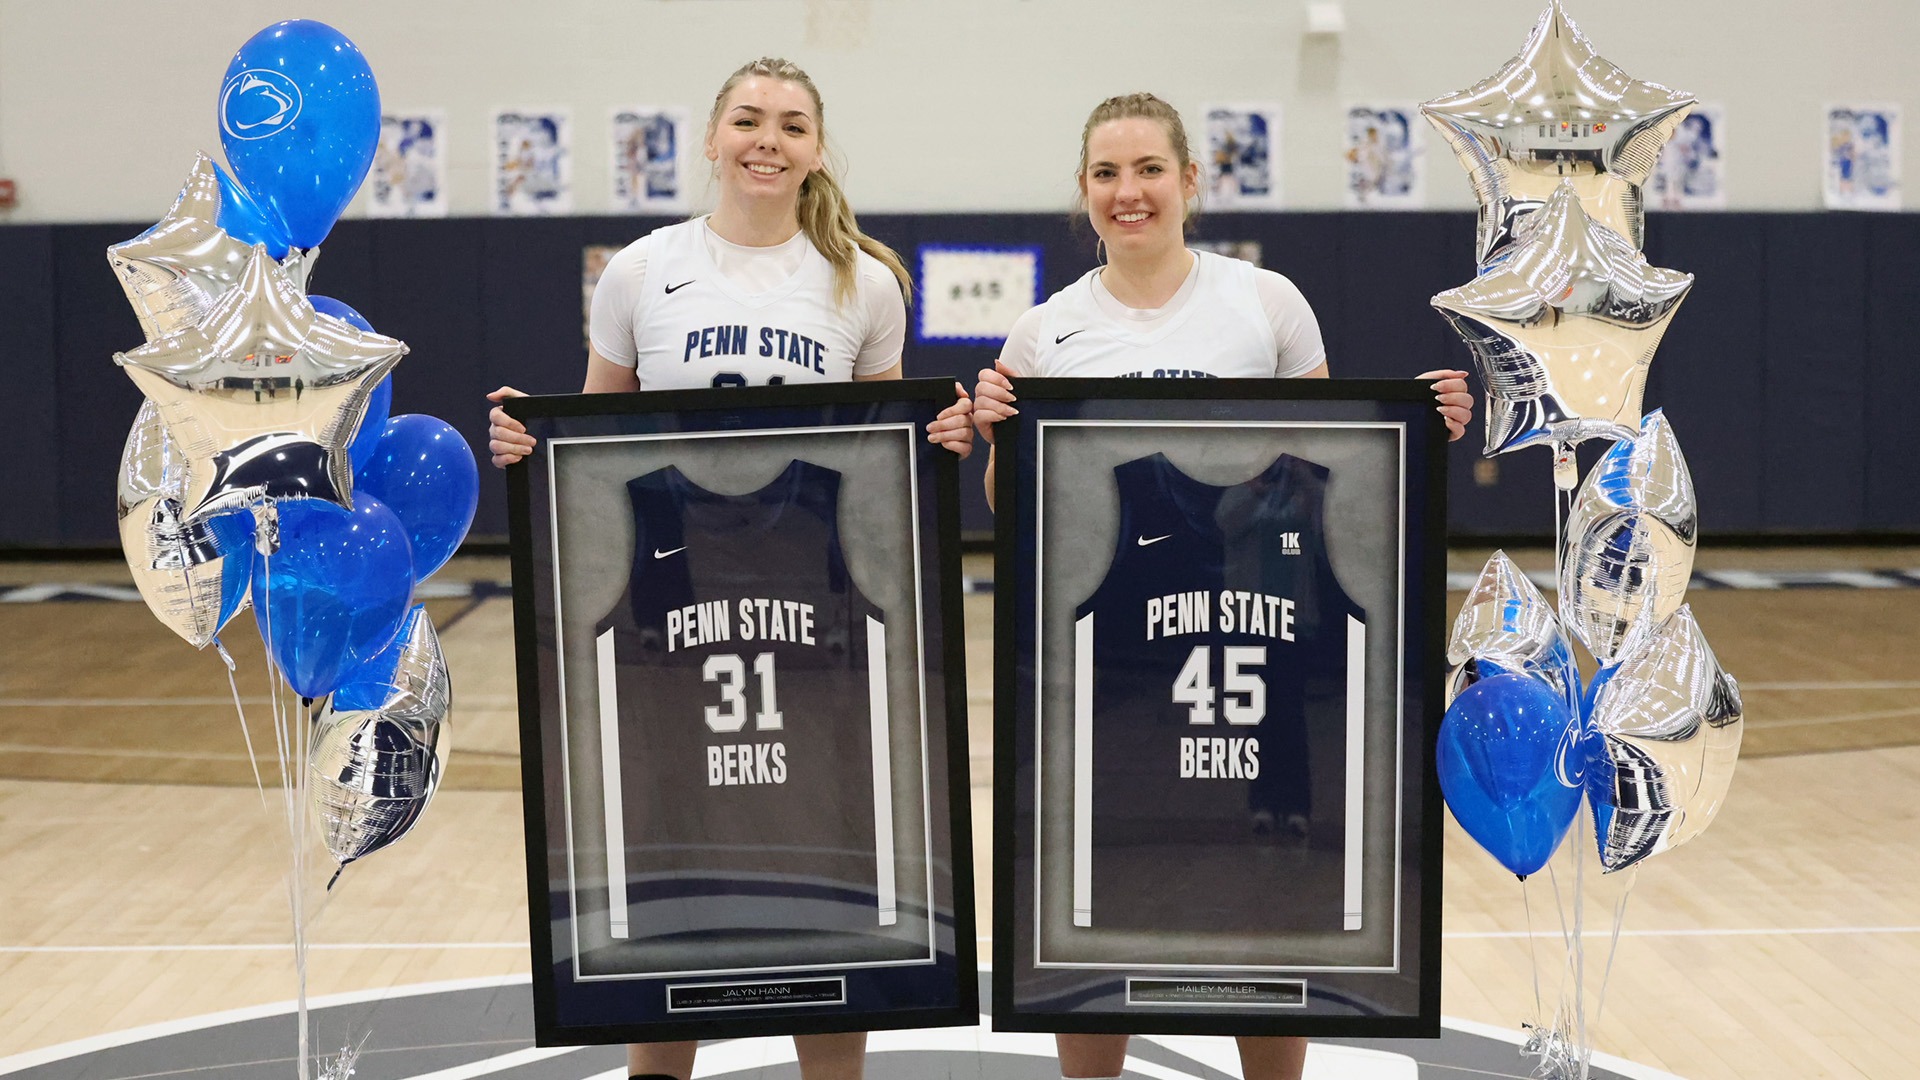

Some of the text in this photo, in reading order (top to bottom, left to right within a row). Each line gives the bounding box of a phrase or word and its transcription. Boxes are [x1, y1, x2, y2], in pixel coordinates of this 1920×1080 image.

[683, 325, 825, 375] PENN STATE
[1279, 532, 1300, 548] 1K
[667, 598, 815, 652] PENN STATE
[1146, 590, 1295, 642] PENN STATE
[702, 652, 784, 733] 31
[1172, 645, 1267, 725] 45
[707, 742, 787, 786] BERKS
[1180, 737, 1259, 780] BERKS
[722, 986, 791, 997] JALYN HANN
[1176, 985, 1257, 994] HAILEY MILLER
